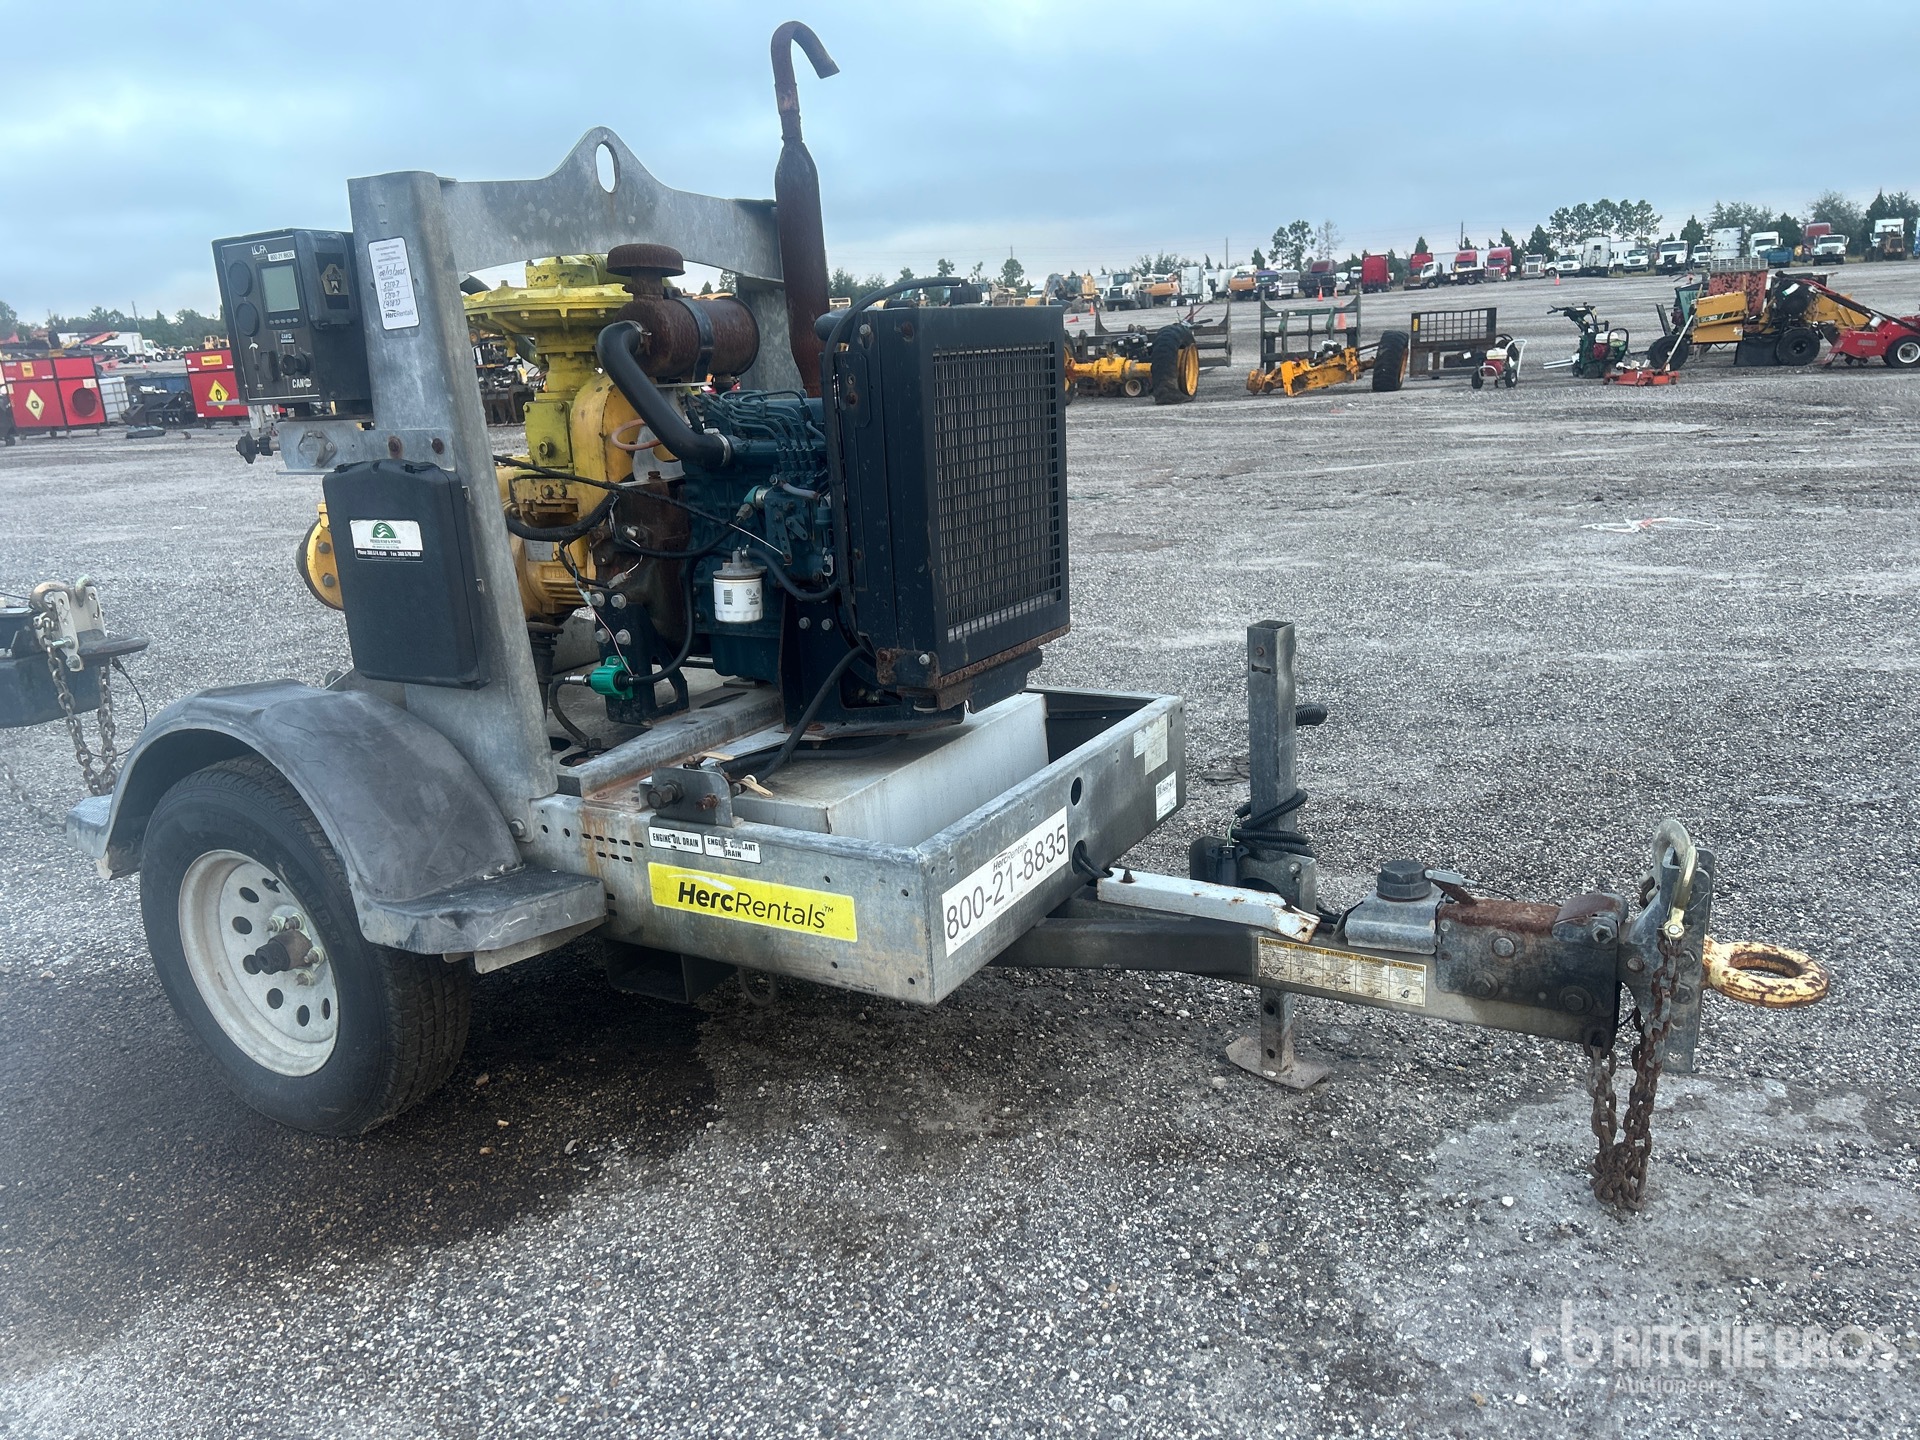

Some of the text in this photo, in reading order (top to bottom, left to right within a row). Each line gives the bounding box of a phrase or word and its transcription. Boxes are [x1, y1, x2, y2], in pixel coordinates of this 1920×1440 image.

[652, 833, 699, 847] ENGINE OIL DRAIN
[707, 837, 728, 848] ENGIE
[946, 823, 1066, 940] 800-21-8835
